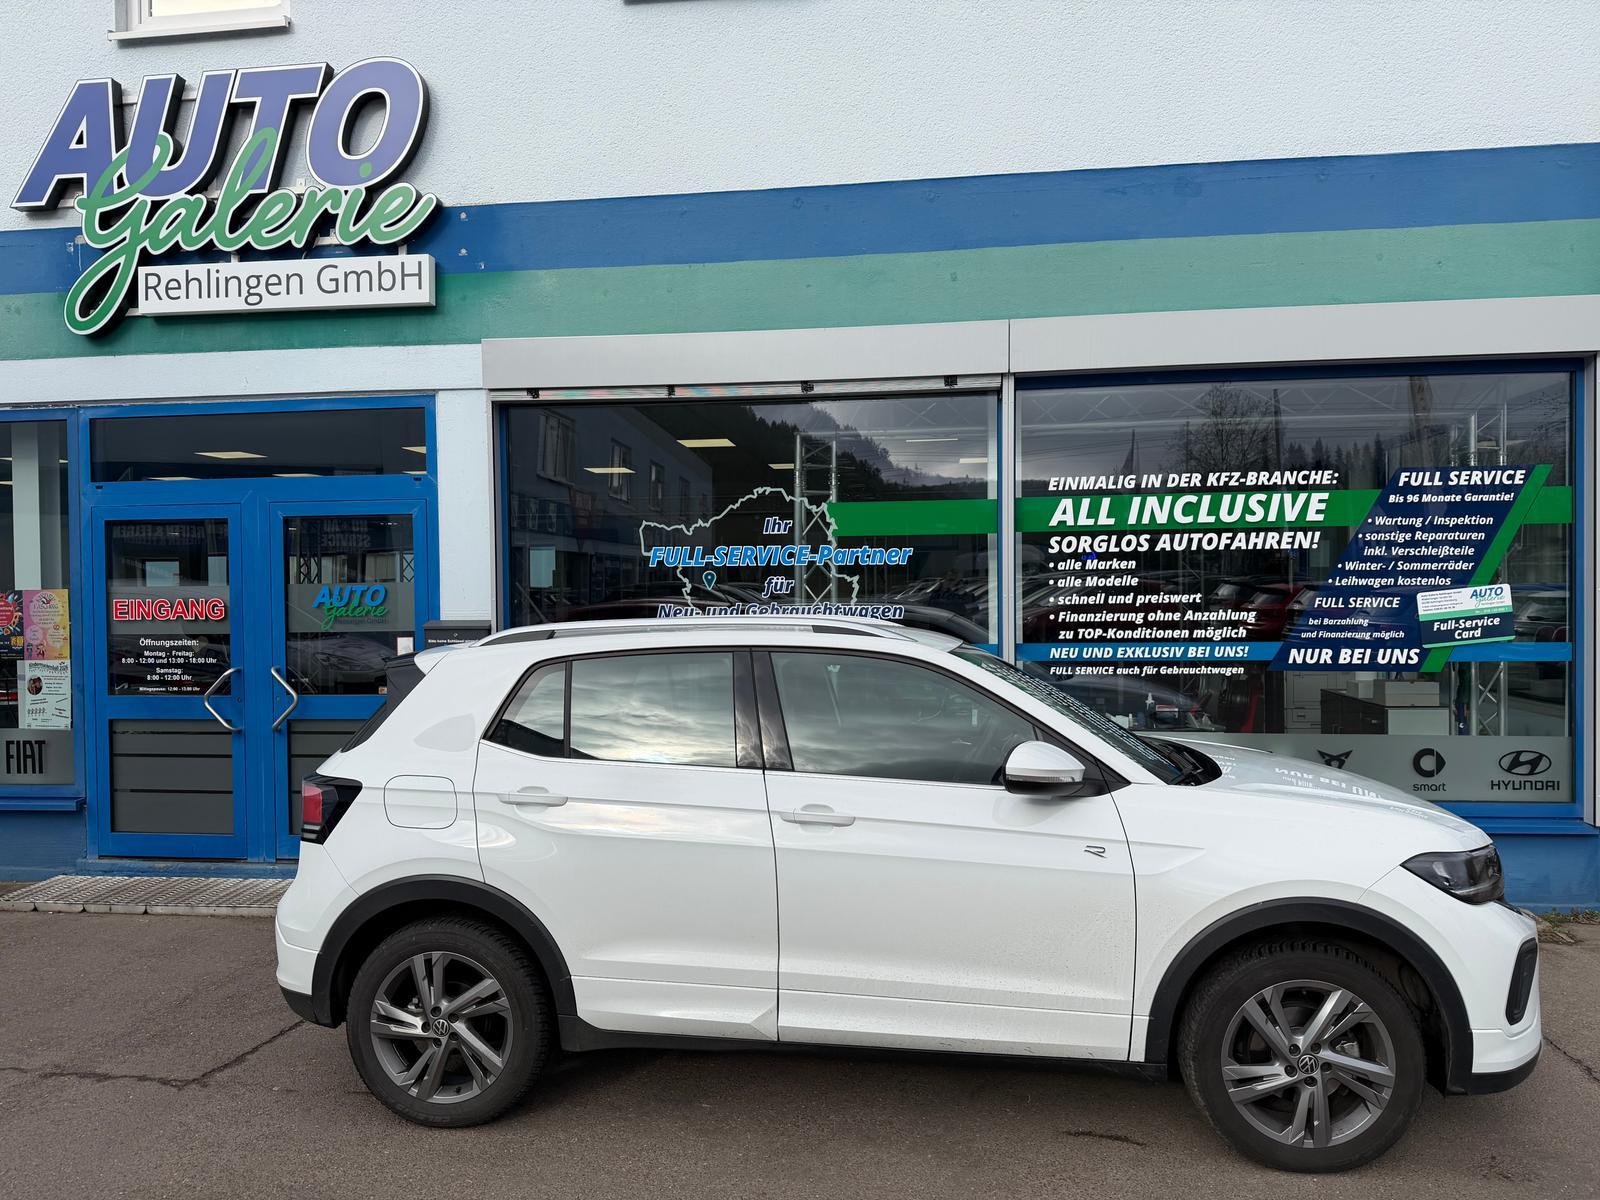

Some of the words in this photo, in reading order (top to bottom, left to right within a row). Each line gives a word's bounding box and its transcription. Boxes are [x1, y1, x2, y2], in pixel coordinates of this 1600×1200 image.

[11, 56, 425, 209] AUTO
[63, 127, 437, 336] Galerie
[144, 270, 304, 306] Rehlingen
[317, 261, 422, 293] GmbH
[1048, 475, 1136, 490] EINMALIG
[1141, 474, 1166, 488] IN
[1167, 472, 1201, 488] DER
[1206, 470, 1339, 487] KFZ-BRANCHE:
[1399, 471, 1443, 486] FULL
[1448, 470, 1526, 485] SERVICE
[1389, 494, 1404, 502] Bis
[1407, 494, 1419, 502] 96
[1422, 494, 1461, 502] Monate
[1464, 493, 1514, 502] Garantie!
[1049, 496, 1116, 527] ALL
[1127, 492, 1329, 525] INCLUSIVE
[763, 517, 793, 534] Ihr
[1375, 516, 1423, 527] Wartung
[1433, 515, 1493, 526] Inspektion
[1048, 534, 1150, 554] SORGLOS
[1156, 531, 1320, 550] AUTOFAHREN!
[1365, 532, 1412, 542] sonstige
[1415, 531, 1485, 542] Reparaturen
[650, 545, 913, 566] FULL-SERVICE-Partner
[1364, 546, 1386, 555] inkl.
[1391, 546, 1474, 557] Verschleißteile
[1058, 559, 1082, 570] alle
[1086, 558, 1136, 569] Marken
[1345, 562, 1386, 570] Winter-
[1397, 561, 1474, 570] Sommerräder
[763, 577, 794, 597] für
[1058, 577, 1082, 587] alle
[1086, 576, 1138, 586] Modelle
[1335, 577, 1395, 587] Leihwagen
[1398, 576, 1451, 585] kostenlos
[312, 585, 386, 608] AUTO
[1469, 586, 1504, 599] AUTO
[1058, 594, 1104, 604] schnell
[1108, 594, 1132, 604] und
[1136, 593, 1201, 606] preiswert
[1314, 598, 1345, 608] FULL
[1348, 597, 1400, 607] SERVICE
[113, 598, 225, 620] EINGANG
[1059, 611, 1144, 624] Finanzierung
[1148, 611, 1180, 621] ohne
[1184, 609, 1256, 623] Anzahlung
[1323, 618, 1369, 626] Barzahlung
[1433, 617, 1500, 631] Full-Service
[1059, 630, 1073, 640] zu
[1077, 628, 1188, 640] TOP-Konditionen
[1193, 627, 1246, 641] möglich
[1318, 631, 1370, 639] Finanzierung
[1373, 630, 1404, 639] möglich
[1455, 628, 1481, 639] Card
[139, 638, 199, 647] Öffnungszeiten:
[1050, 647, 1079, 659] NEU
[1083, 647, 1112, 659] UND
[1117, 647, 1184, 659] EXKLUSIV
[1188, 647, 1209, 658] BEI
[1213, 646, 1249, 658] UNS!
[1288, 649, 1332, 664] NUR
[1338, 649, 1369, 664] BEI
[1377, 648, 1419, 664] UNS
[1050, 667, 1074, 675] FULL
[1076, 667, 1114, 675] SERVICE
[1116, 667, 1140, 675] auch
[1142, 667, 1157, 676] für
[1160, 666, 1244, 676] Gebrauchtwagen
[6, 740, 46, 774] FIAT
[1413, 782, 1446, 792] smart
[1491, 779, 1559, 791] HYUNDAI
